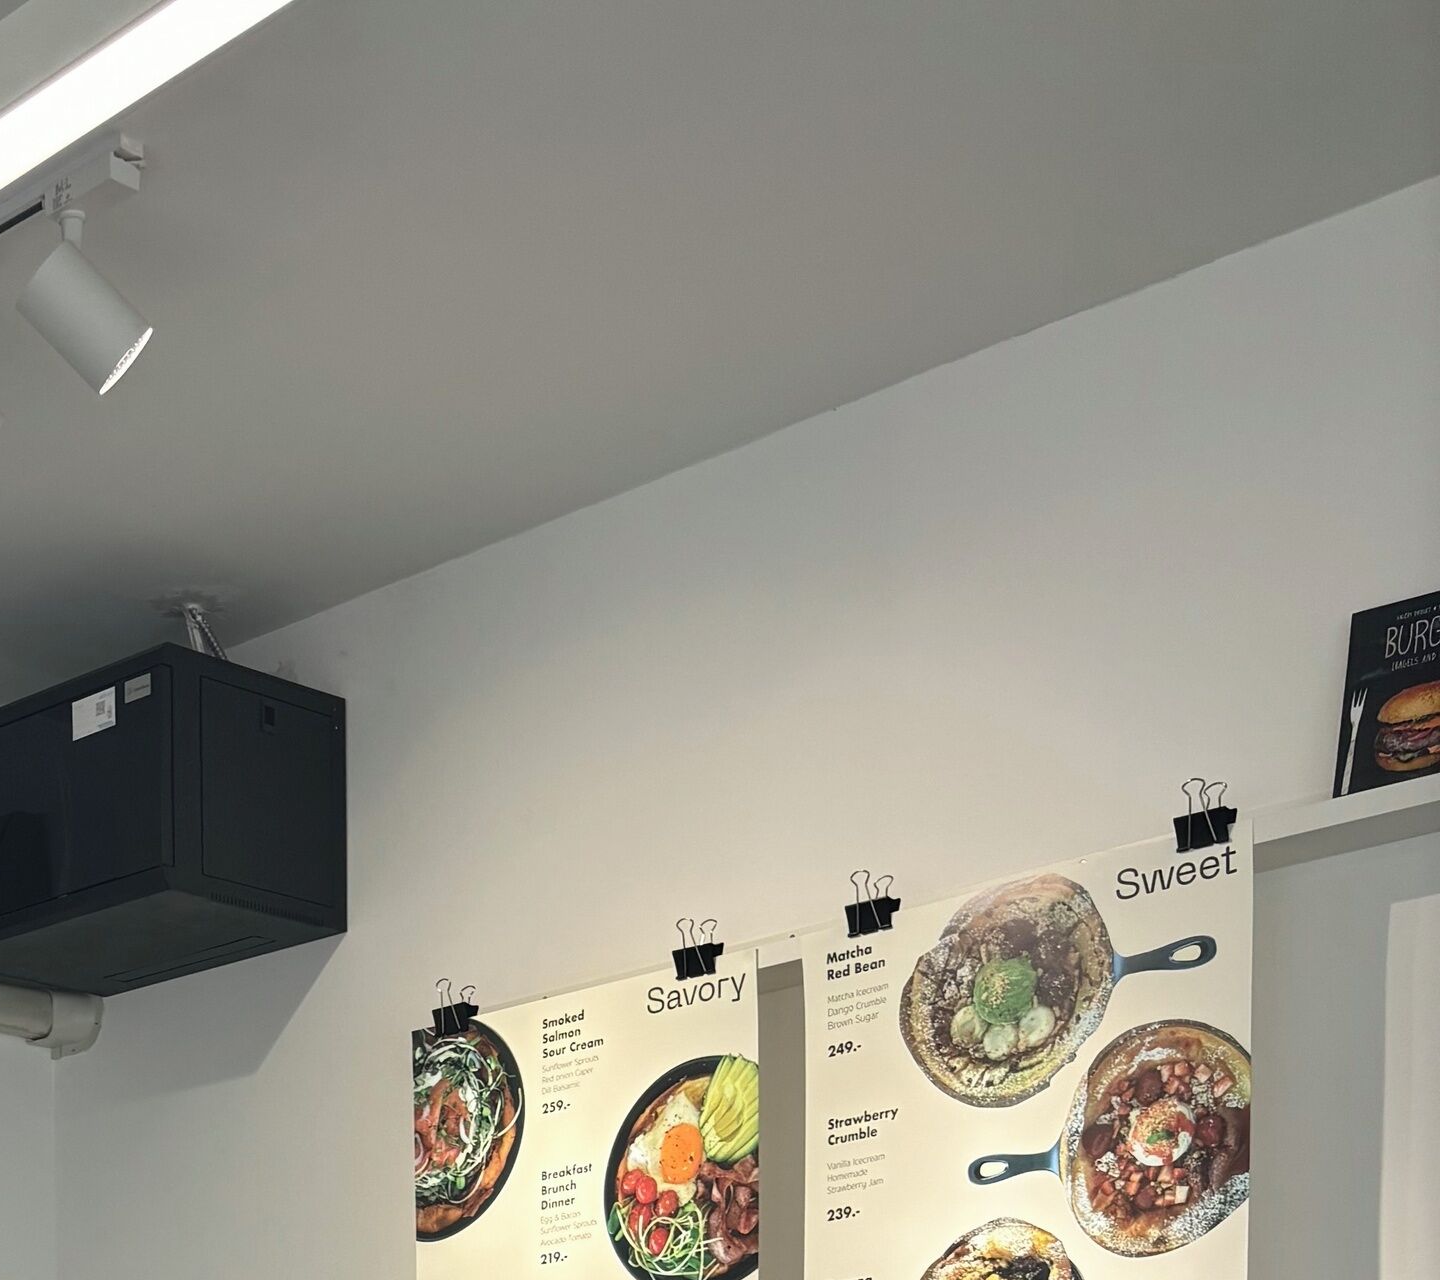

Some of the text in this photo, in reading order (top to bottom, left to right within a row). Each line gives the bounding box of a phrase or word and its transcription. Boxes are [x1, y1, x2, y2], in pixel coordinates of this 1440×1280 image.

[1115, 845, 1238, 901] Sweet
[826, 945, 872, 965] Matcha
[827, 959, 886, 981] Red Bean
[647, 973, 746, 1014] Savory
[827, 991, 855, 1004] Matcha
[827, 996, 887, 1017] Dango Crumble
[542, 1009, 585, 1029] Smoked
[827, 1011, 880, 1031] Brown Sugar
[542, 1027, 581, 1044] Salmon
[542, 1037, 604, 1059] Sour Cream
[828, 1040, 862, 1058] 249.-
[542, 1100, 571, 1114] 259.-
[828, 1108, 899, 1130] Strawberry
[827, 1126, 878, 1146] Crumble
[541, 1163, 593, 1181] Breakfast
[541, 1180, 577, 1195] Brunch
[827, 1180, 867, 1195] Strawberry
[541, 1197, 575, 1210] Dinner
[827, 1206, 861, 1222] 239.-
[540, 1251, 568, 1265] 219.-
